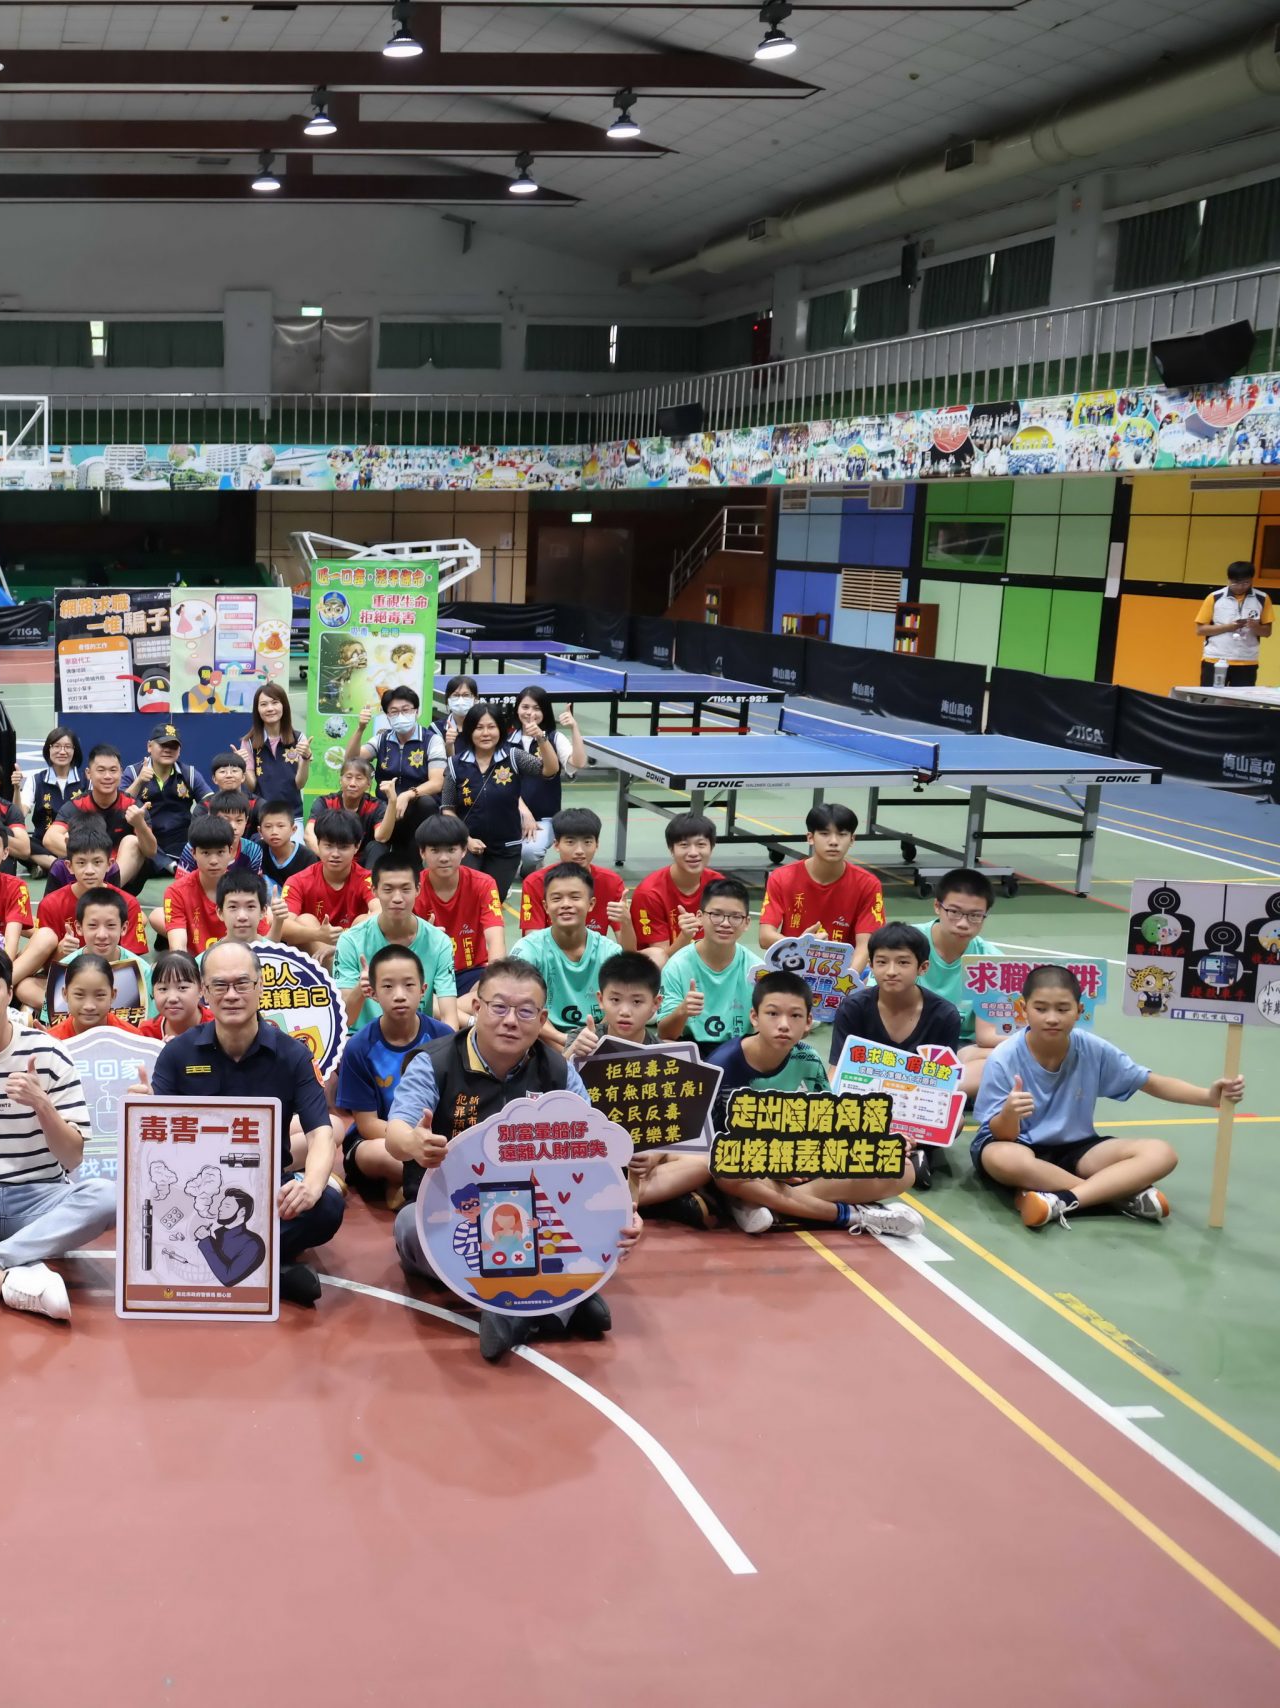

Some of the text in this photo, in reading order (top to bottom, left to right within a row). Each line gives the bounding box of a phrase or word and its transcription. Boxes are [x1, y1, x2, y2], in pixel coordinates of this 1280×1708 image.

[60, 593, 130, 619] 網路求職
[372, 594, 429, 609] 重視生命
[359, 609, 417, 625] 拒絕毒害
[8, 628, 42, 636] STIGA
[707, 695, 768, 703] STIGA ST-925
[1066, 725, 1104, 743] STIGA
[1223, 753, 1276, 777] 海山高中
[646, 771, 665, 784] DONIC
[697, 780, 744, 788] DONIC
[1095, 775, 1141, 783] DONIC
[806, 957, 845, 977] 165
[966, 961, 1103, 997] 求職阱
[259, 986, 331, 1010] 保護自己
[606, 1059, 680, 1079] 拒絕毒品
[608, 1102, 681, 1123] 全民反毒
[731, 1095, 890, 1133] 走出陰暗角落
[139, 1116, 260, 1145] 毒害一生
[498, 1121, 588, 1142] 別當暈船仔
[499, 1139, 608, 1163] 遠離人財兩失
[714, 1138, 904, 1175] 迎接無毒新生活
